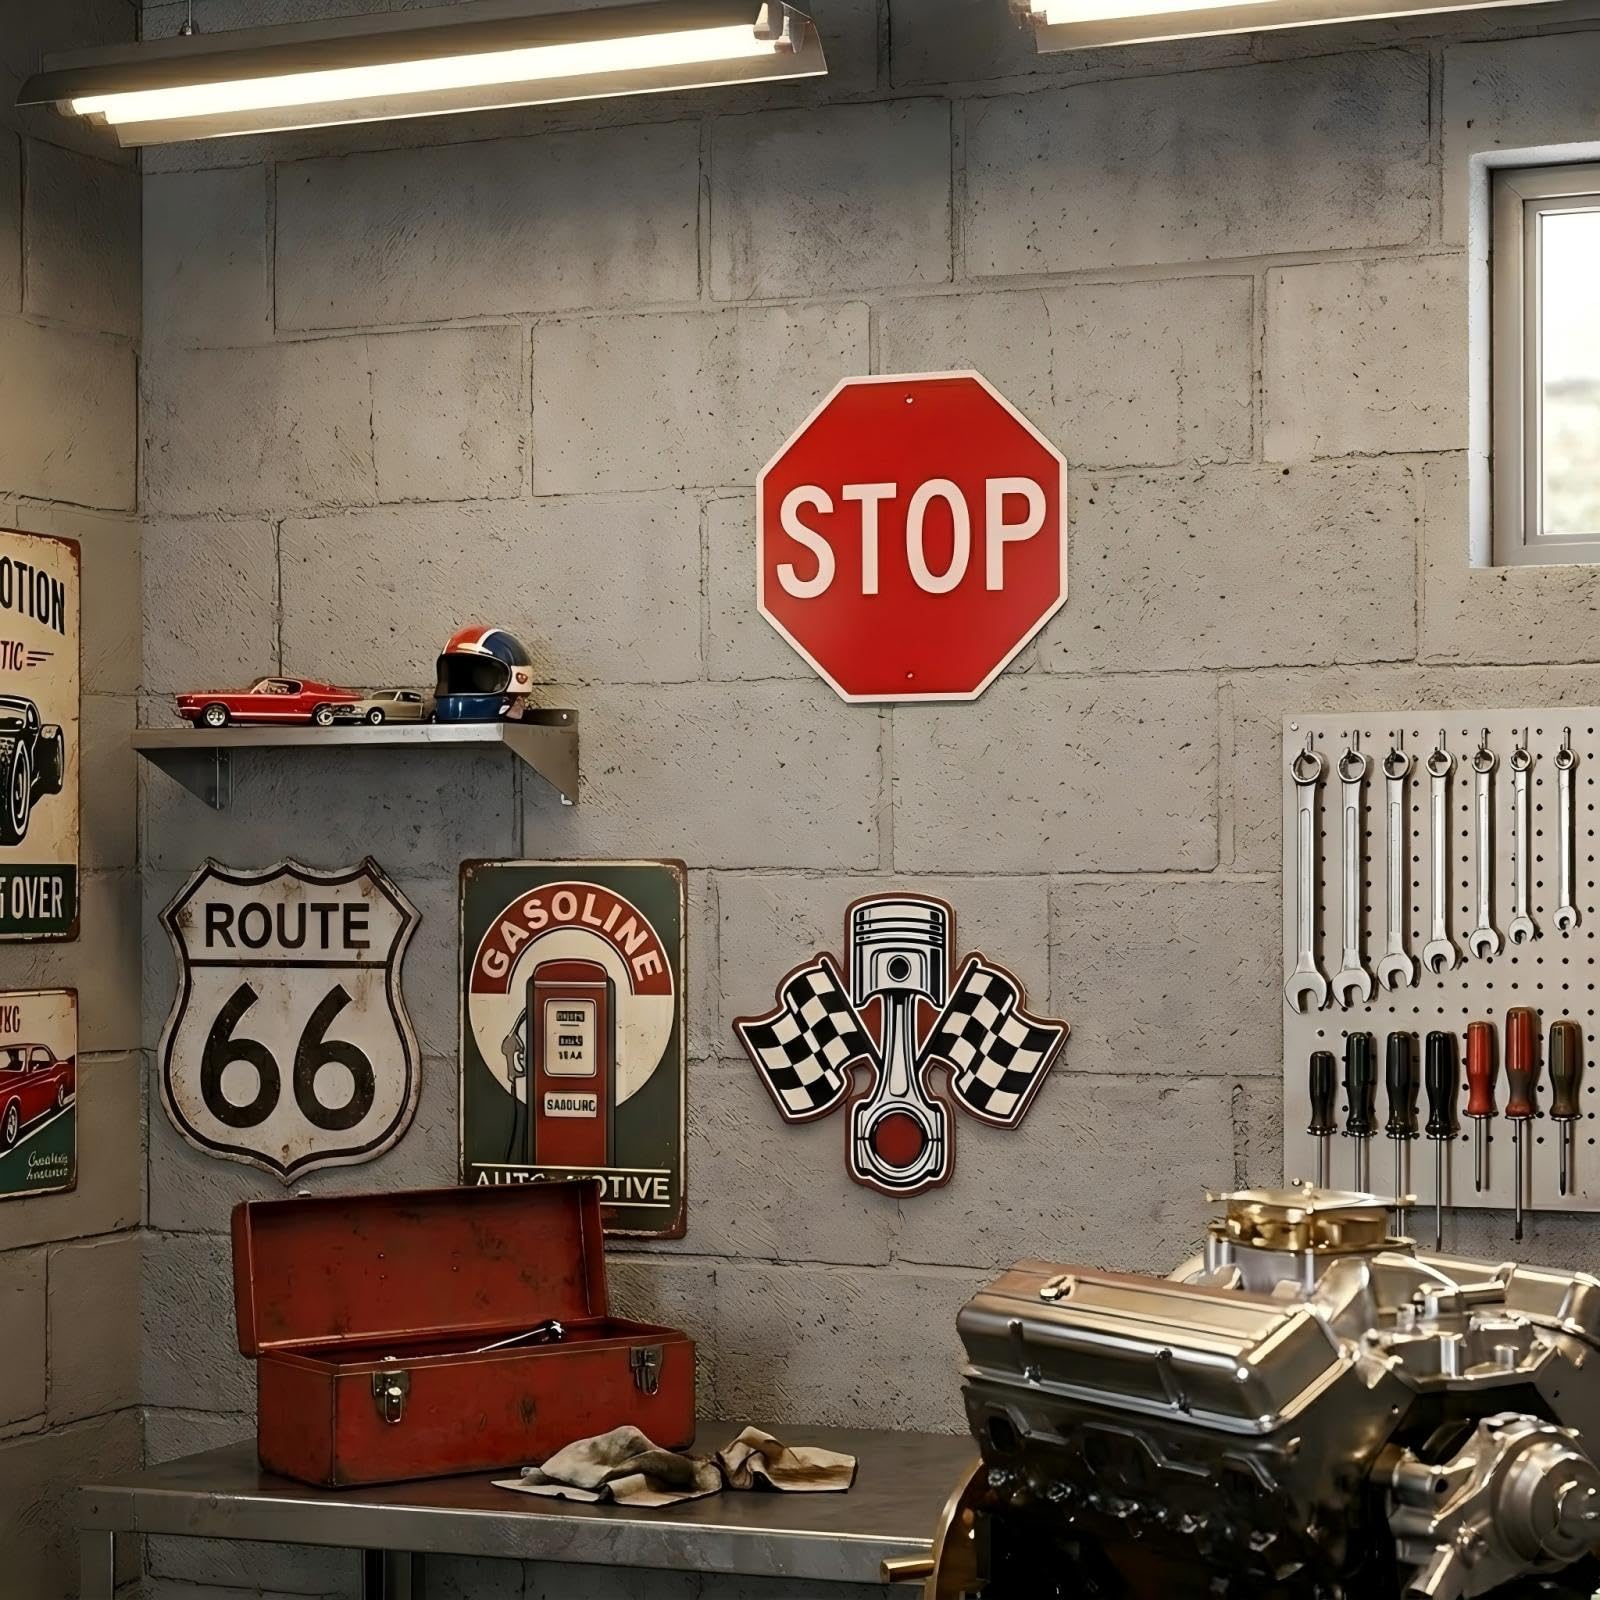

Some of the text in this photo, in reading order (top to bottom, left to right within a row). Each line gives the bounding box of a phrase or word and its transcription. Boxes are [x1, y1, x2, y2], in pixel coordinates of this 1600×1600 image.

[776, 477, 1047, 599] STOP
[0, 556, 65, 636] OTION
[0, 641, 24, 671] TIC
[12, 876, 63, 919] OVER
[205, 902, 371, 949] ROUTE
[482, 890, 663, 981] GASOLINE
[200, 981, 376, 1131] 66
[477, 1171, 670, 1200] AUTOTIVE
